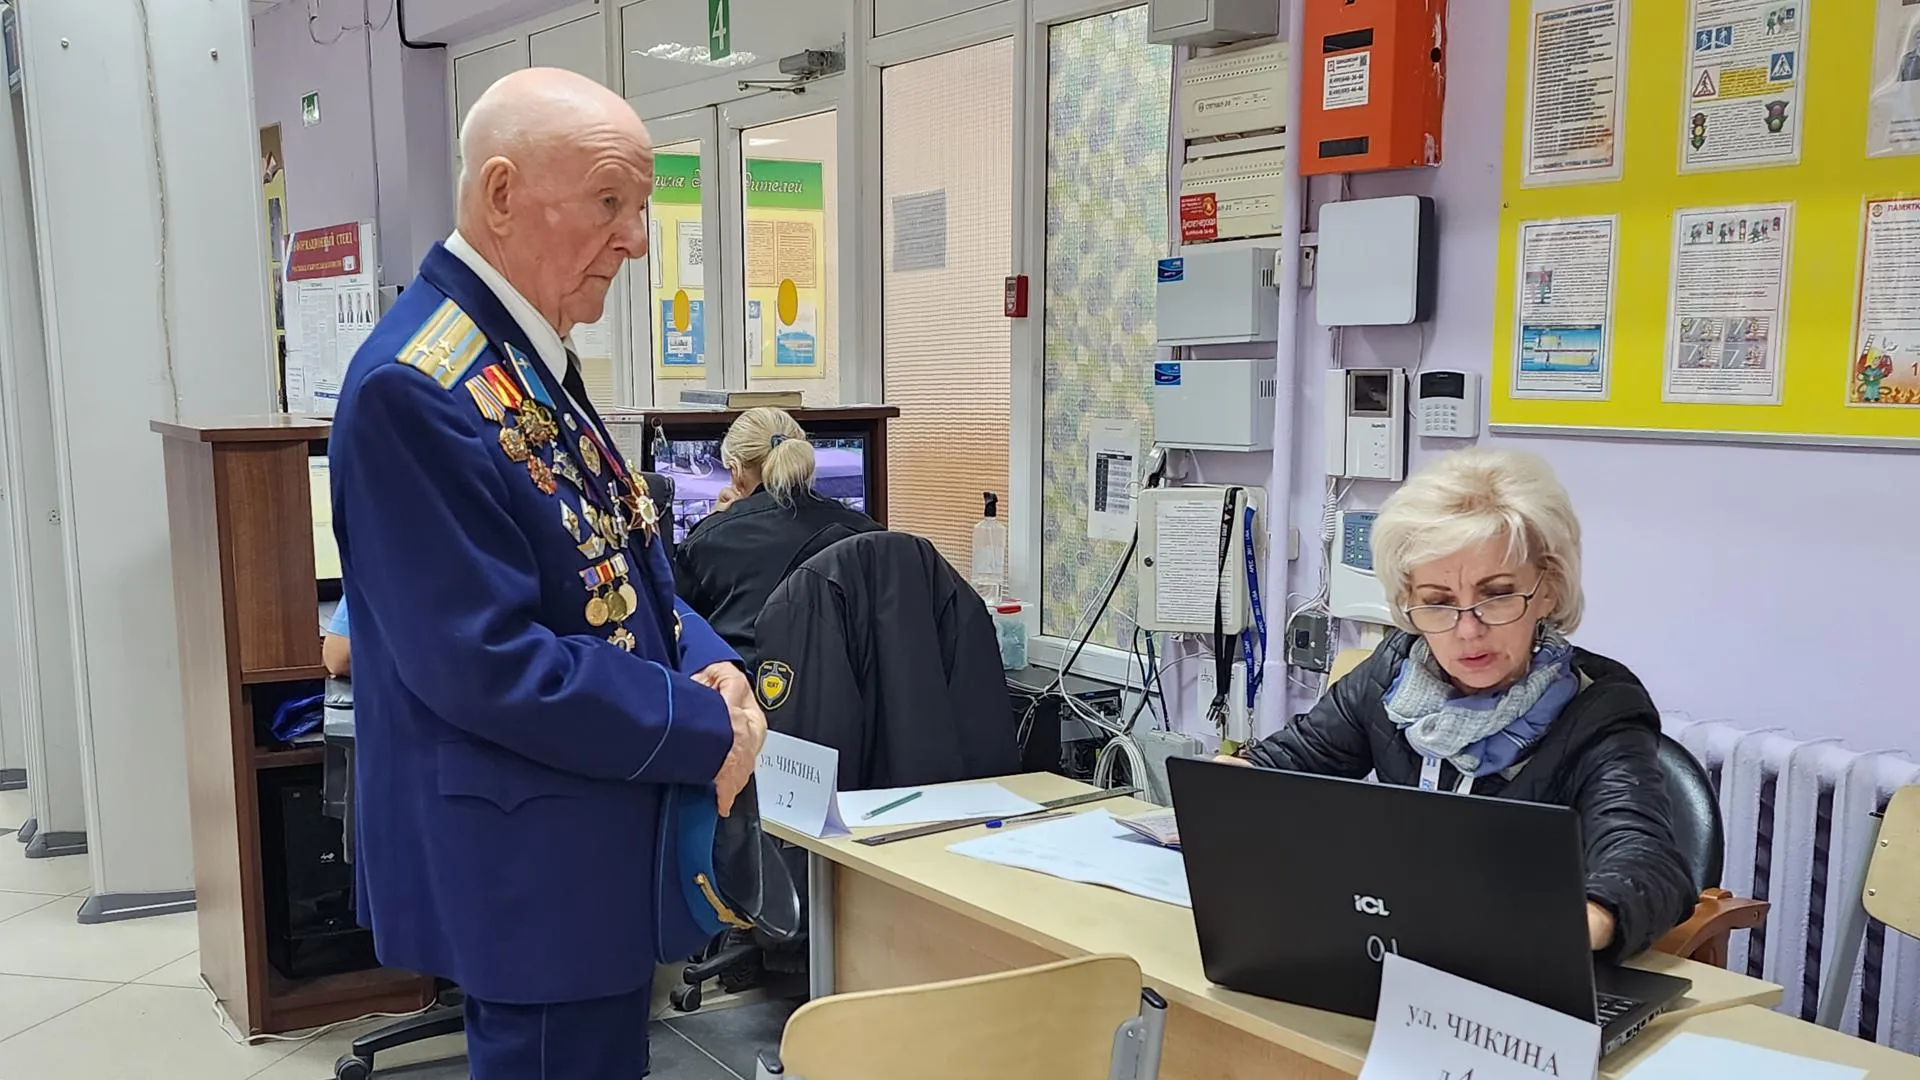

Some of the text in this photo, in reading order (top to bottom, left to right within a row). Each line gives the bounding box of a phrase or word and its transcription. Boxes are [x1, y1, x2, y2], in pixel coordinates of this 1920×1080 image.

[711, 0, 727, 50] 4
[760, 754, 821, 785] ул. ЧИКИНА
[786, 791, 794, 809] 2
[1405, 1004, 1560, 1078] ул. ЧИКИНА
